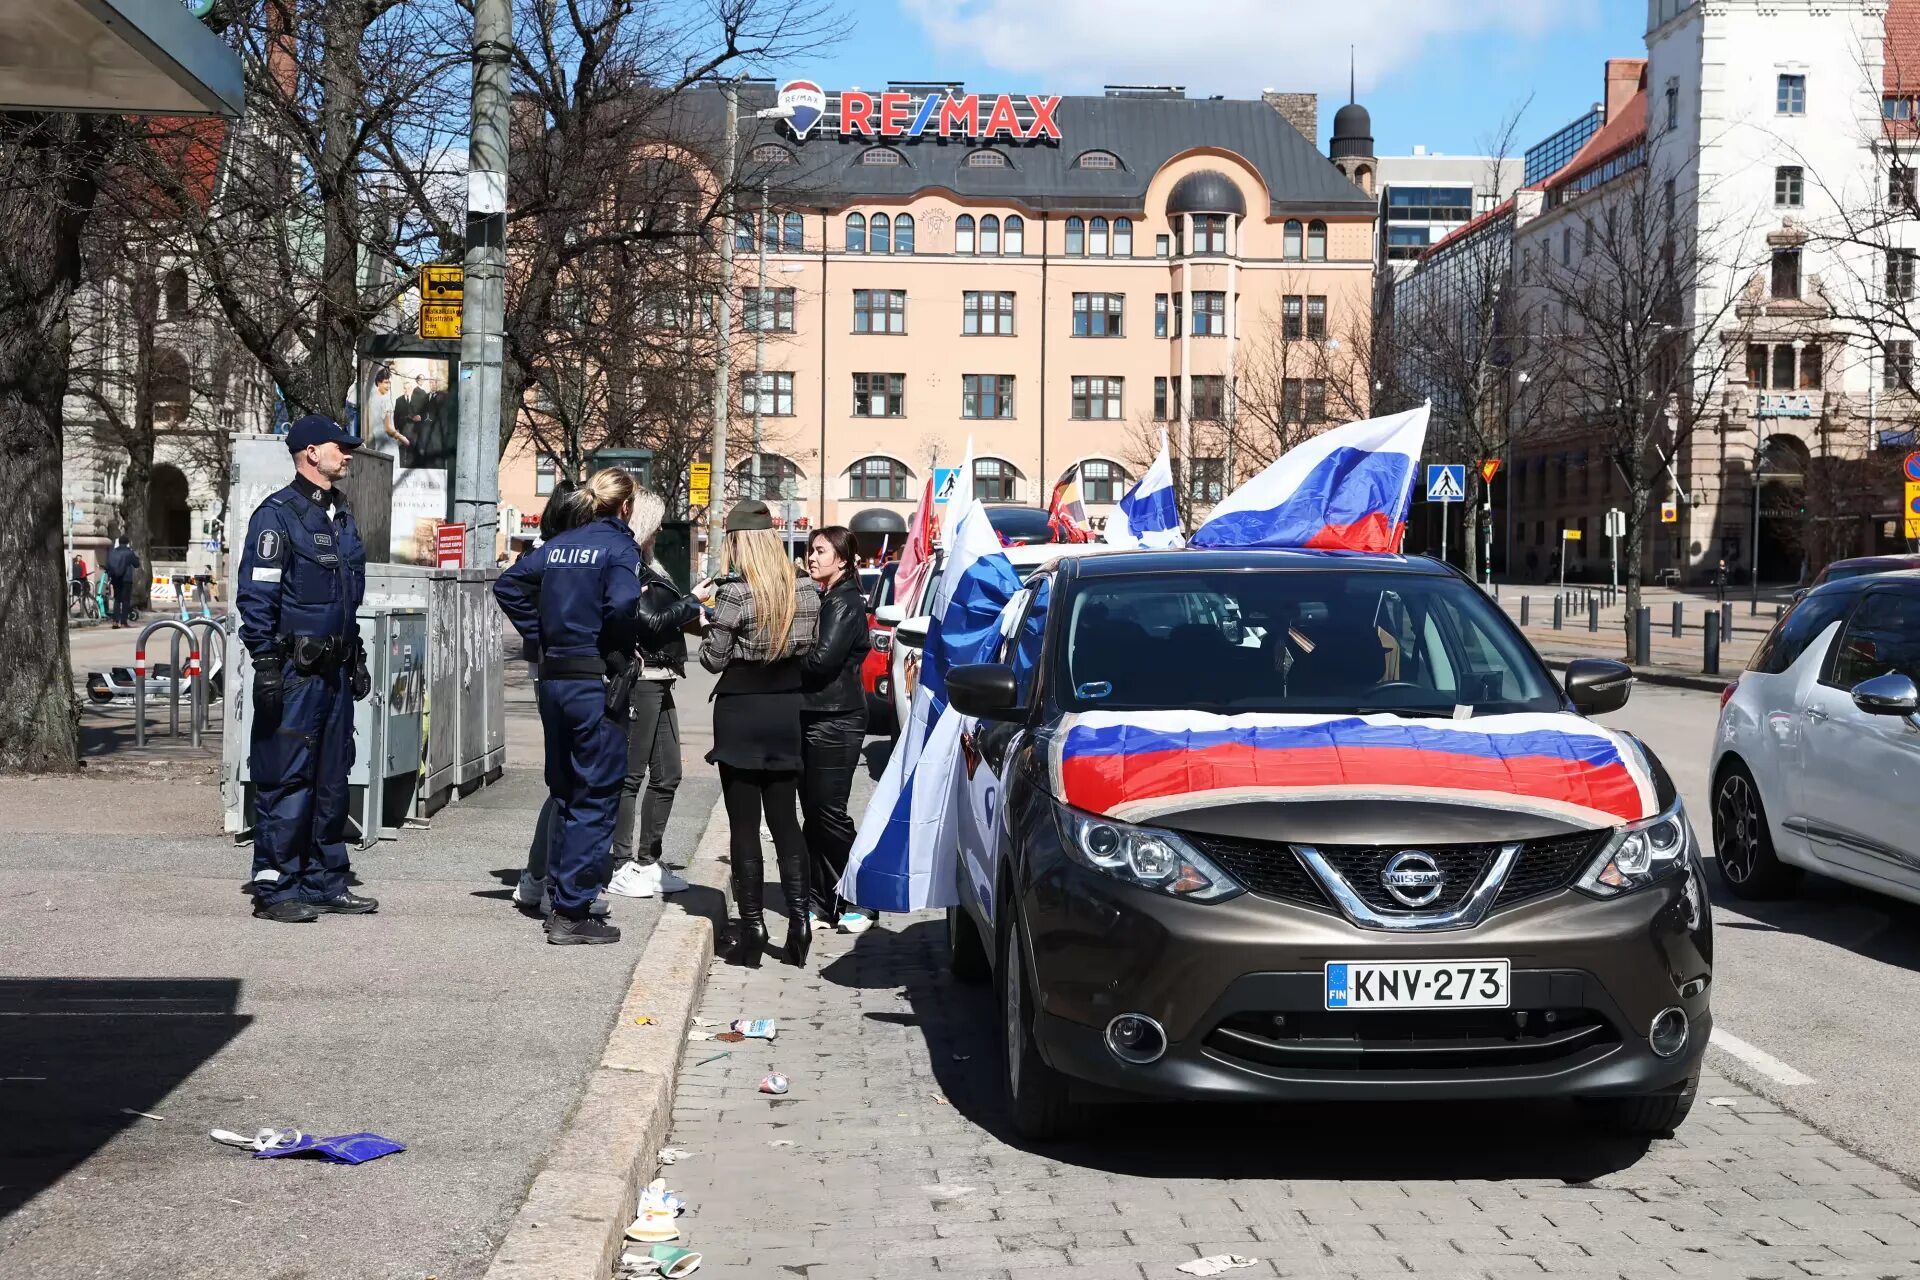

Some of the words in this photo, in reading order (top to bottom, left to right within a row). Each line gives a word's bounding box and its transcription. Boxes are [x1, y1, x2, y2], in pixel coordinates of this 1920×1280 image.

[785, 94, 818, 104] RE/MAX
[840, 92, 1063, 138] RE/MAX
[546, 548, 599, 565] OLIISI
[1390, 874, 1441, 883] NISSAN
[1329, 990, 1346, 1000] FIN
[1355, 968, 1500, 1001] KNV-273
